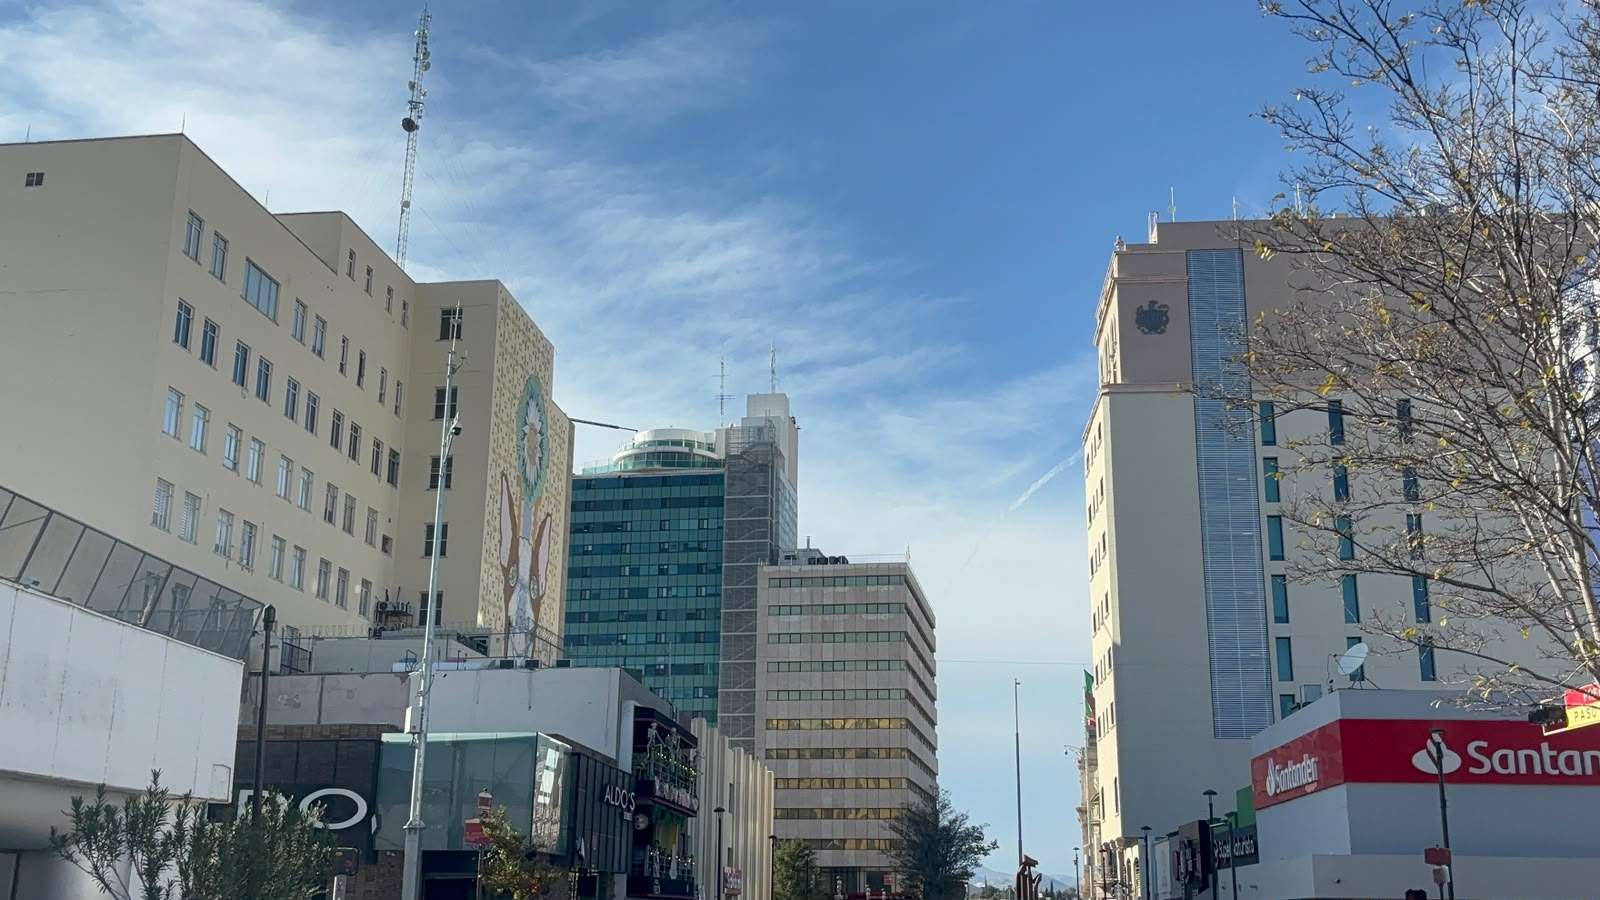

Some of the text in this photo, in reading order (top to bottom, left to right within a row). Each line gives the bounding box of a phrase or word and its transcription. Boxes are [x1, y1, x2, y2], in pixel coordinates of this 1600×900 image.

[1275, 753, 1318, 794] Santander
[1466, 740, 1600, 776] Santan
[604, 784, 635, 811] ALDO'S
